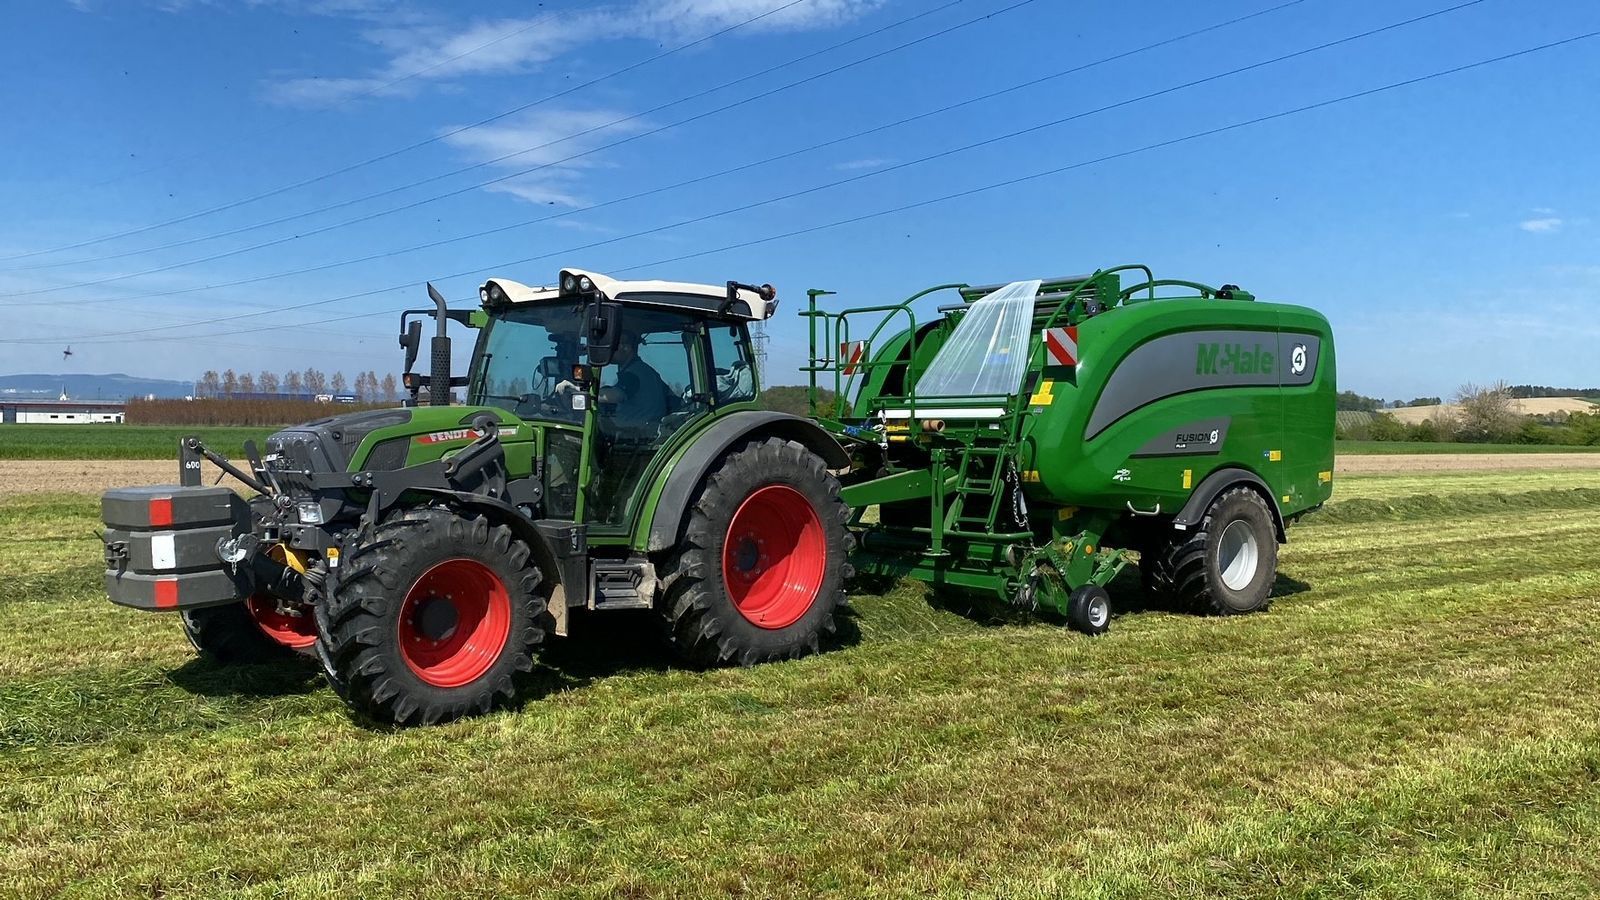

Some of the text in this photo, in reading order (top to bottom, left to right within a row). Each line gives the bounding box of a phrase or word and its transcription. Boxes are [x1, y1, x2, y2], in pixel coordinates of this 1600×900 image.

[428, 428, 469, 442] FENDT
[1176, 433, 1210, 442] FUSION
[185, 460, 200, 469] 600
